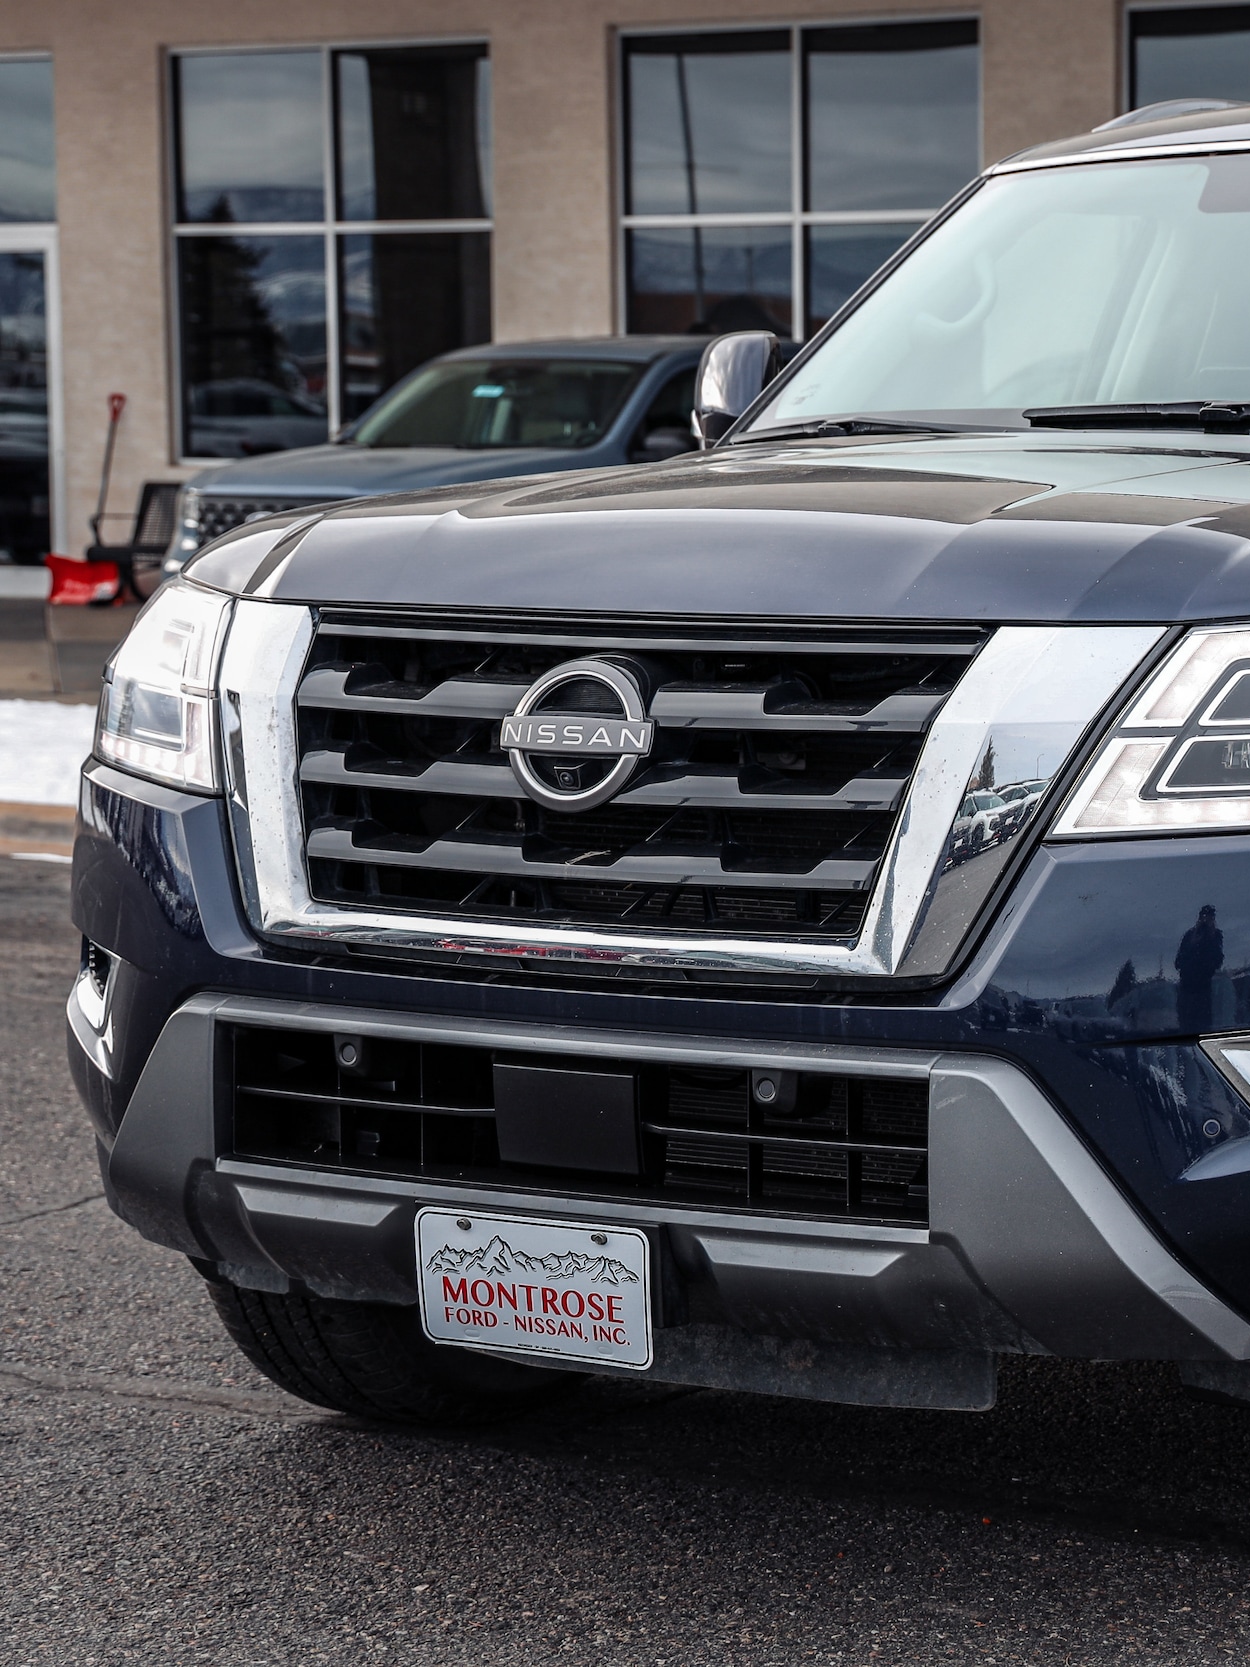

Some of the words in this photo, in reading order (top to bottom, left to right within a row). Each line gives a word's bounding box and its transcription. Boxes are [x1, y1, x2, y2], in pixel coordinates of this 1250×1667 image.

[504, 723, 646, 749] NISSAN
[441, 1275, 625, 1324] MONTROSE
[444, 1306, 498, 1328] FORD
[514, 1314, 589, 1343] NISSAN,
[592, 1324, 632, 1347] INC.
